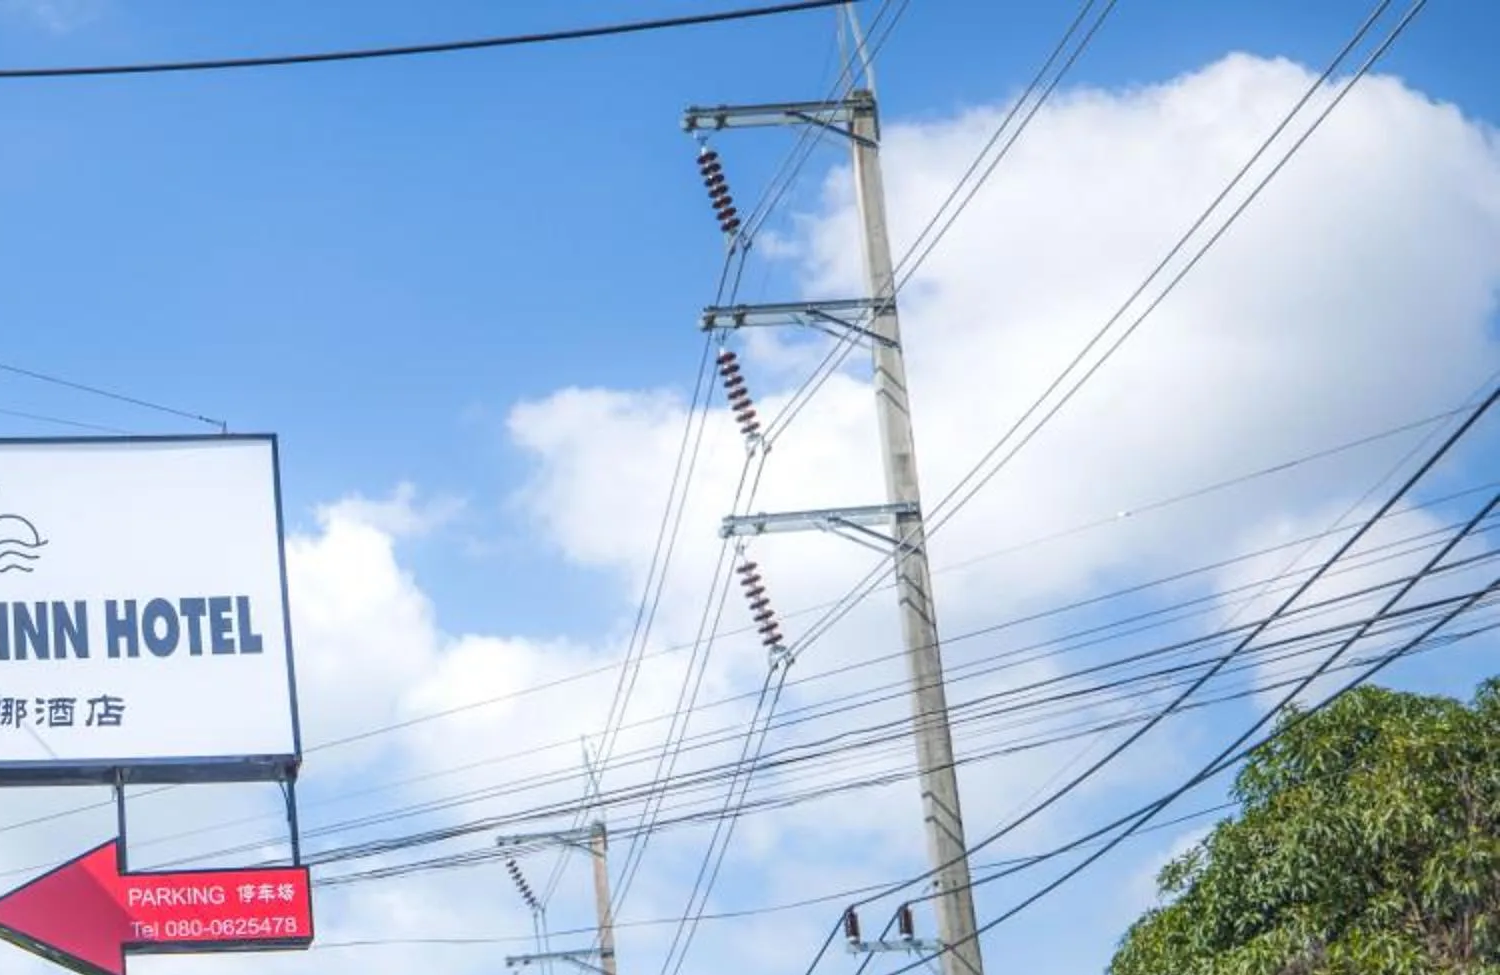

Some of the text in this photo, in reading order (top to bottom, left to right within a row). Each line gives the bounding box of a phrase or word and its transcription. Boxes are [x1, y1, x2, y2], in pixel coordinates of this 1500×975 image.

[105, 596, 263, 658] HOTEL
[127, 883, 296, 908] PARKING 停车场
[132, 916, 298, 939] Tel 080-0625478
